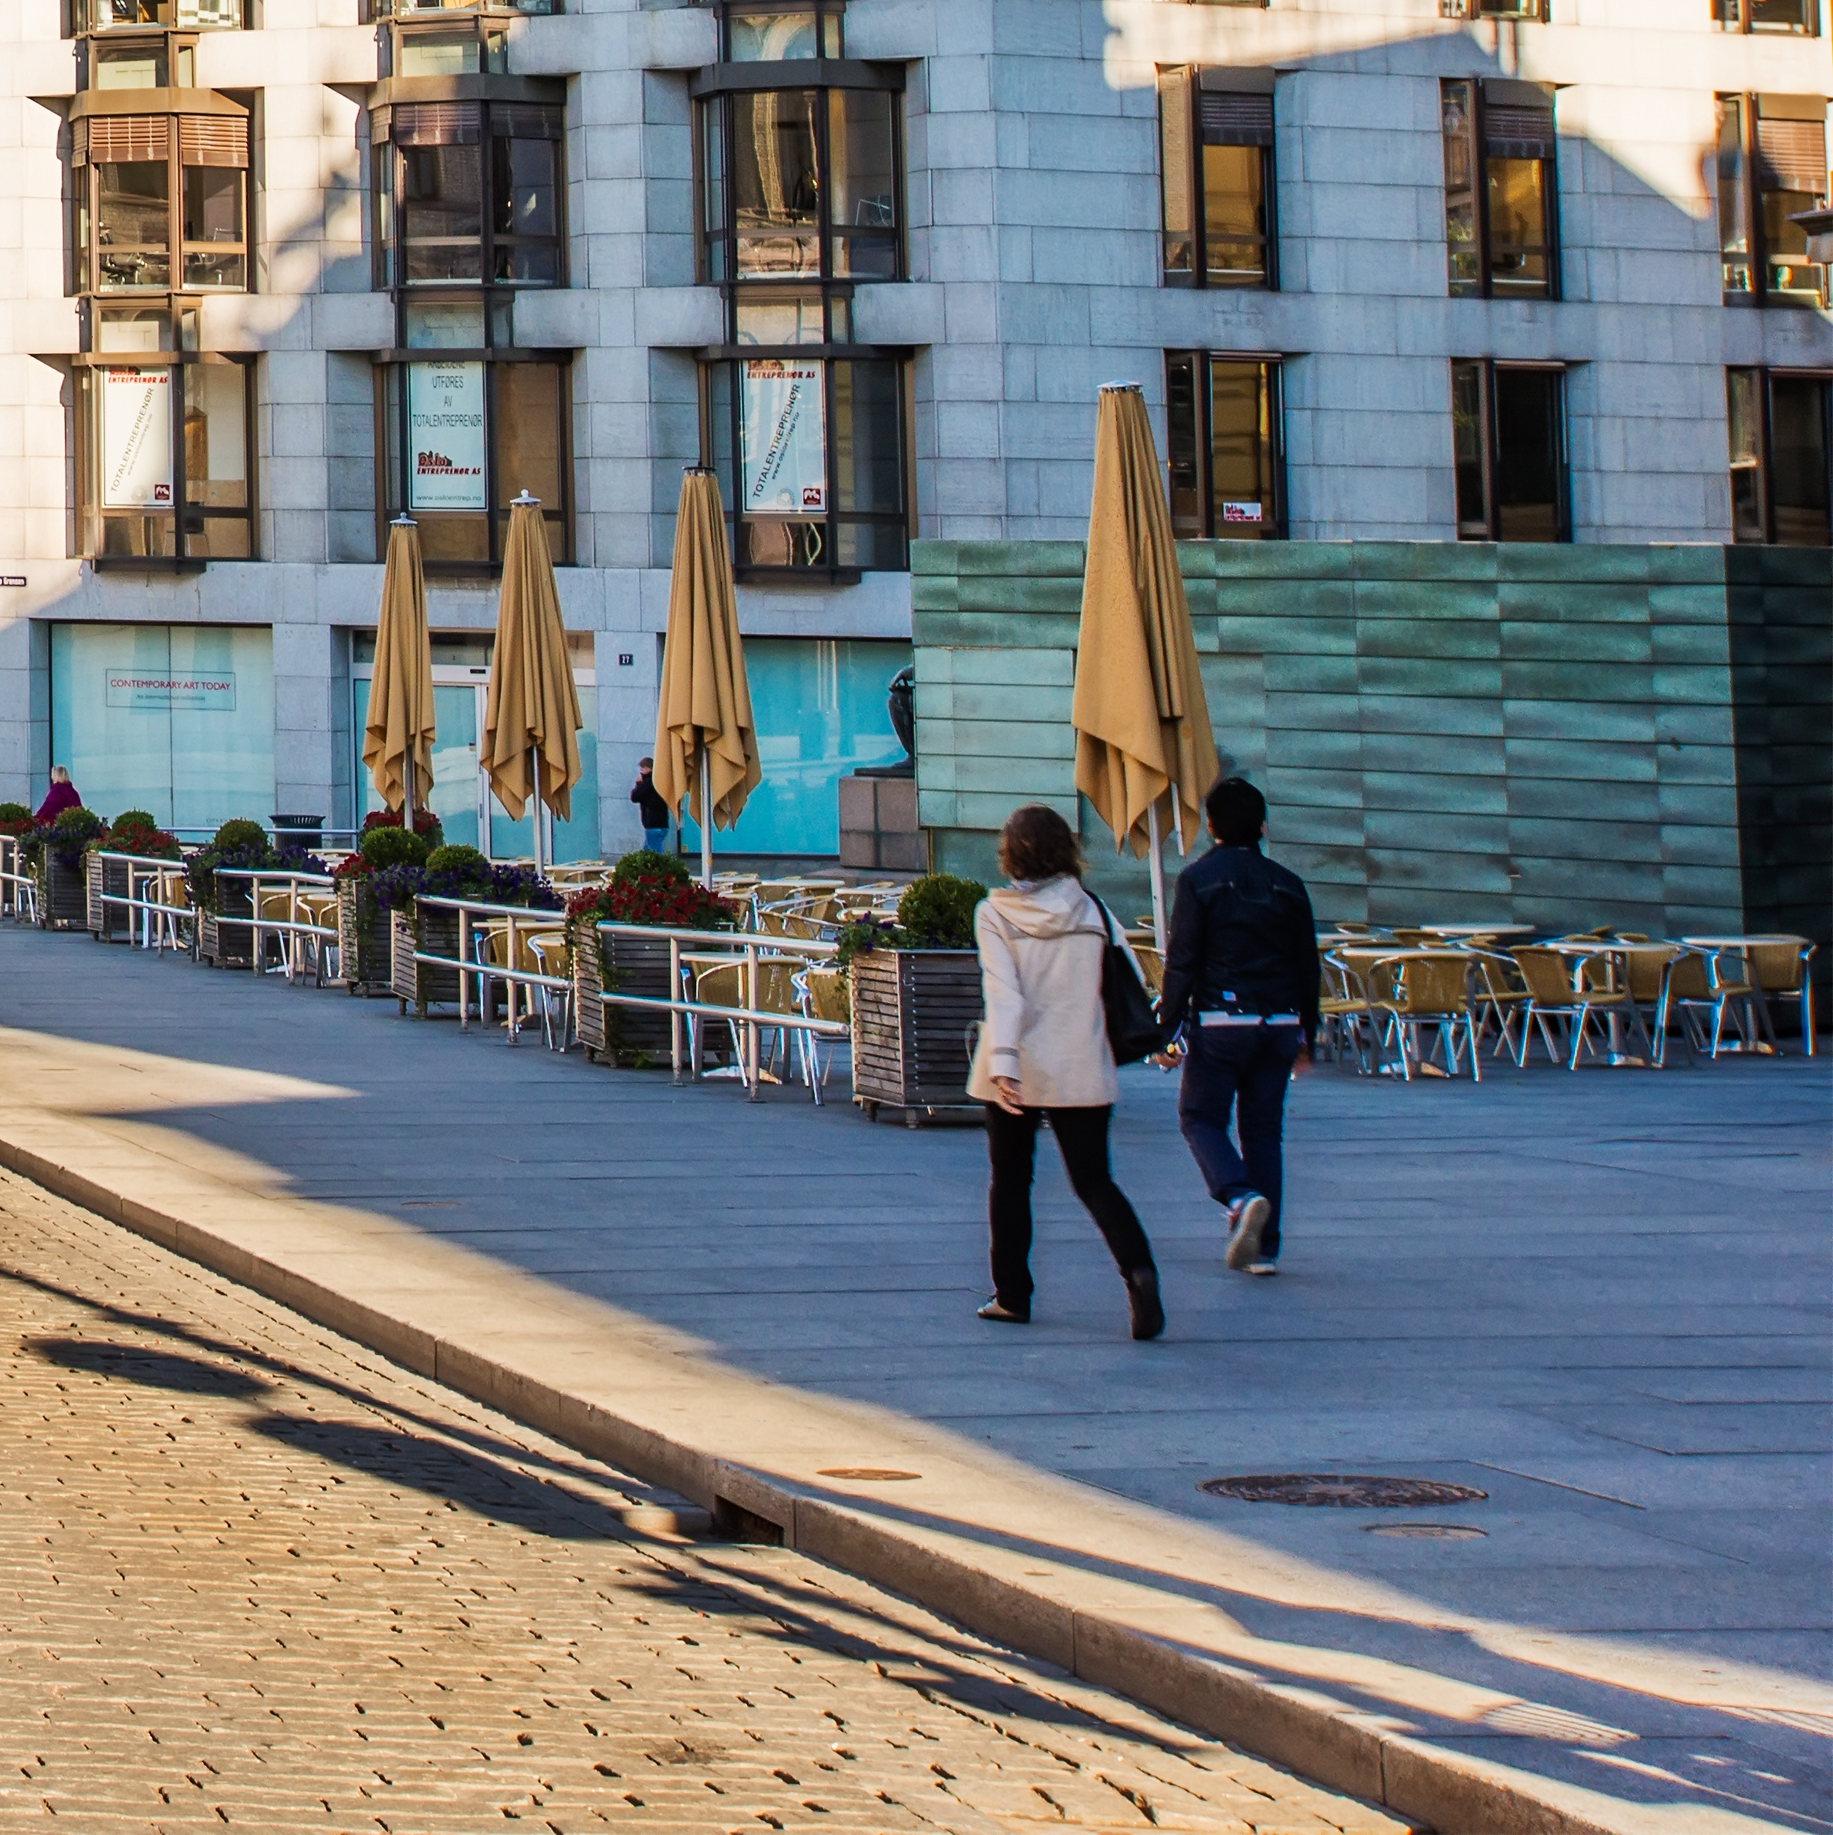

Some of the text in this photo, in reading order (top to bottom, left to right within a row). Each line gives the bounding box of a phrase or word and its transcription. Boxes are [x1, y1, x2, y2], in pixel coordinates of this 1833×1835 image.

[159, 376, 168, 384] AS
[806, 371, 816, 379] AS
[432, 375, 464, 389] UTFØRES
[443, 395, 453, 407] AV
[413, 414, 483, 428] TOTALENTREPRENØR
[110, 387, 155, 493] TOTALENTREPRENØR
[752, 384, 801, 498] TOTALENTREPRENØR
[471, 467, 481, 475] AS
[622, 655, 630, 664] 27
[110, 679, 232, 691] CONTEMPORARY ART TODAY
